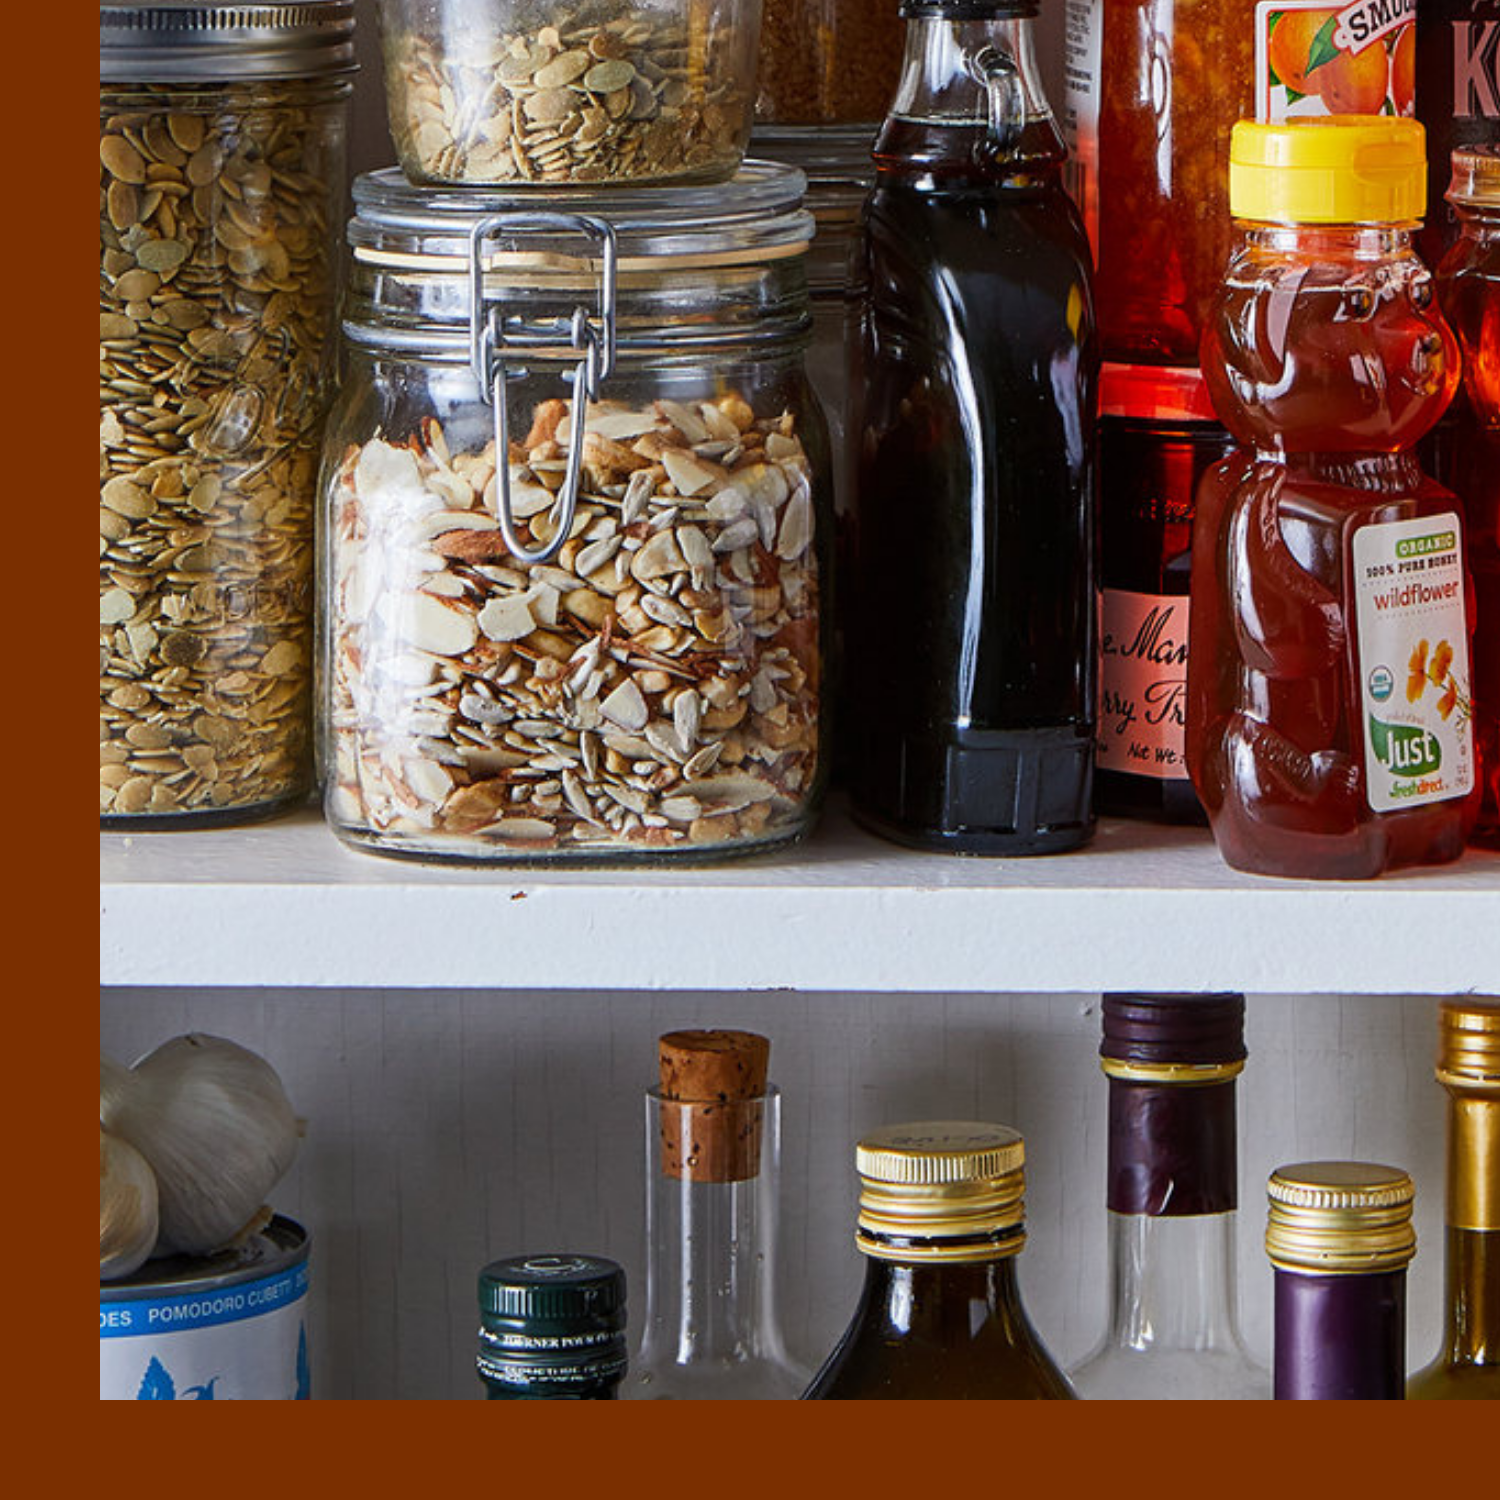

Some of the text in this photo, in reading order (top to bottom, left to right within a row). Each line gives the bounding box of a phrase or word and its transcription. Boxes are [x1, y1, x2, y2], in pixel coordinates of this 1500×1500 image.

[1374, 579, 1459, 611] wildflower
[1383, 729, 1435, 770] Just
[149, 1294, 245, 1323] POMODORO
